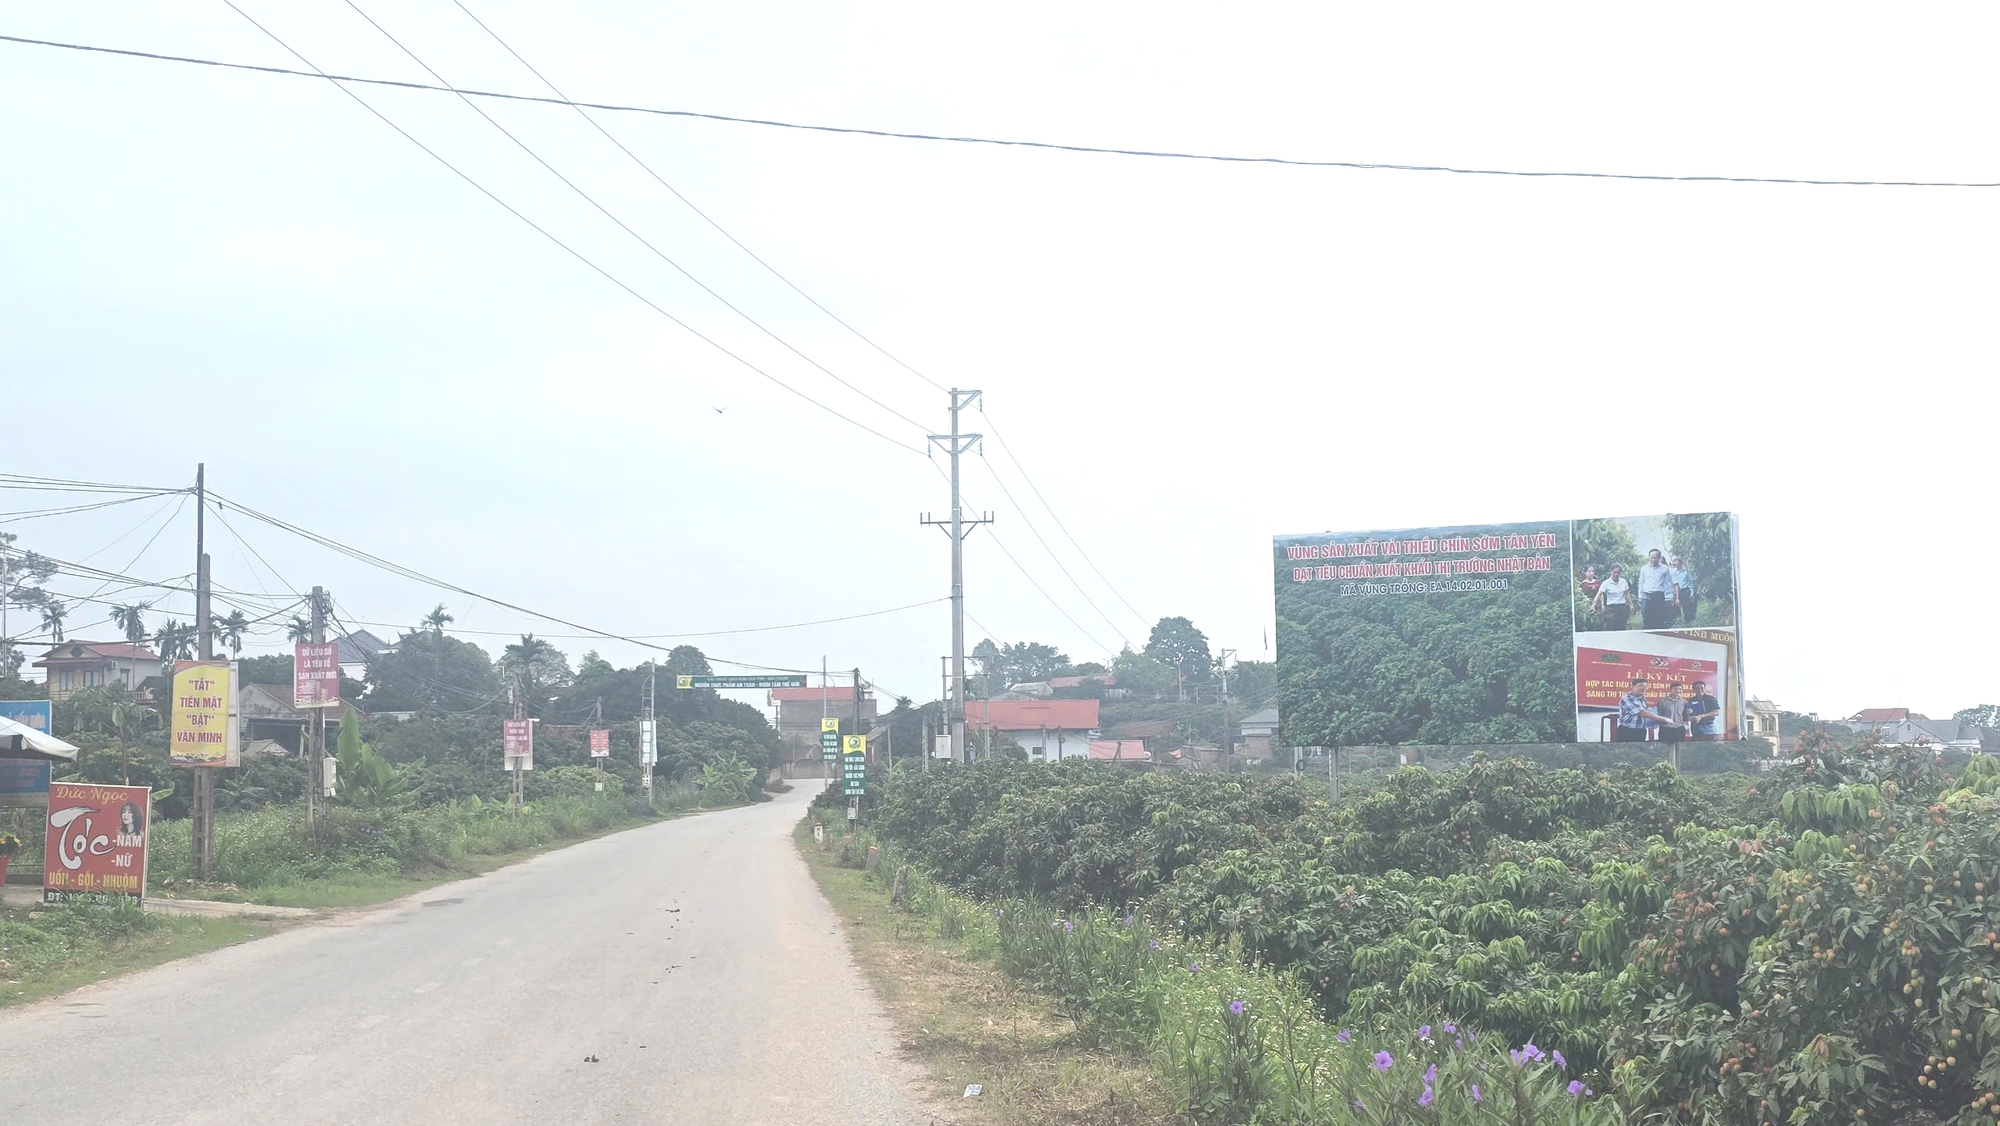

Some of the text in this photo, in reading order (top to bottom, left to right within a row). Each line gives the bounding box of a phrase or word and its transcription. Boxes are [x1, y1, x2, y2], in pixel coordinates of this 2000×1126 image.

[1287, 543, 1319, 560] VÙNG
[1321, 540, 1345, 558] SẢN
[1348, 538, 1378, 557] XUẤT
[1380, 537, 1401, 556] VẢI
[1440, 535, 1469, 552] CHÍN
[1472, 534, 1500, 551] SỚM
[1503, 533, 1528, 550] TÂN
[1530, 531, 1556, 548] YÊN
[1293, 553, 1551, 583] ĐẠT TIÊU CHUẨN XUẤT KHẨU THỊ TRƯỜNG NHẬT BẢN
[1340, 582, 1357, 596] MÃ
[1358, 582, 1388, 596] VÙNG
[1666, 671, 1687, 682] KẾT
[1586, 690, 1605, 698] SANG
[180, 695, 222, 711] TIỀN MẶT
[176, 730, 222, 743] VĂN MINH
[56, 786, 129, 804] Đức Ngọc
[50, 806, 115, 870] Tóc
[49, 869, 69, 885] UỐN
[78, 871, 94, 889] GỘI
[103, 873, 138, 890] NHUỘM
